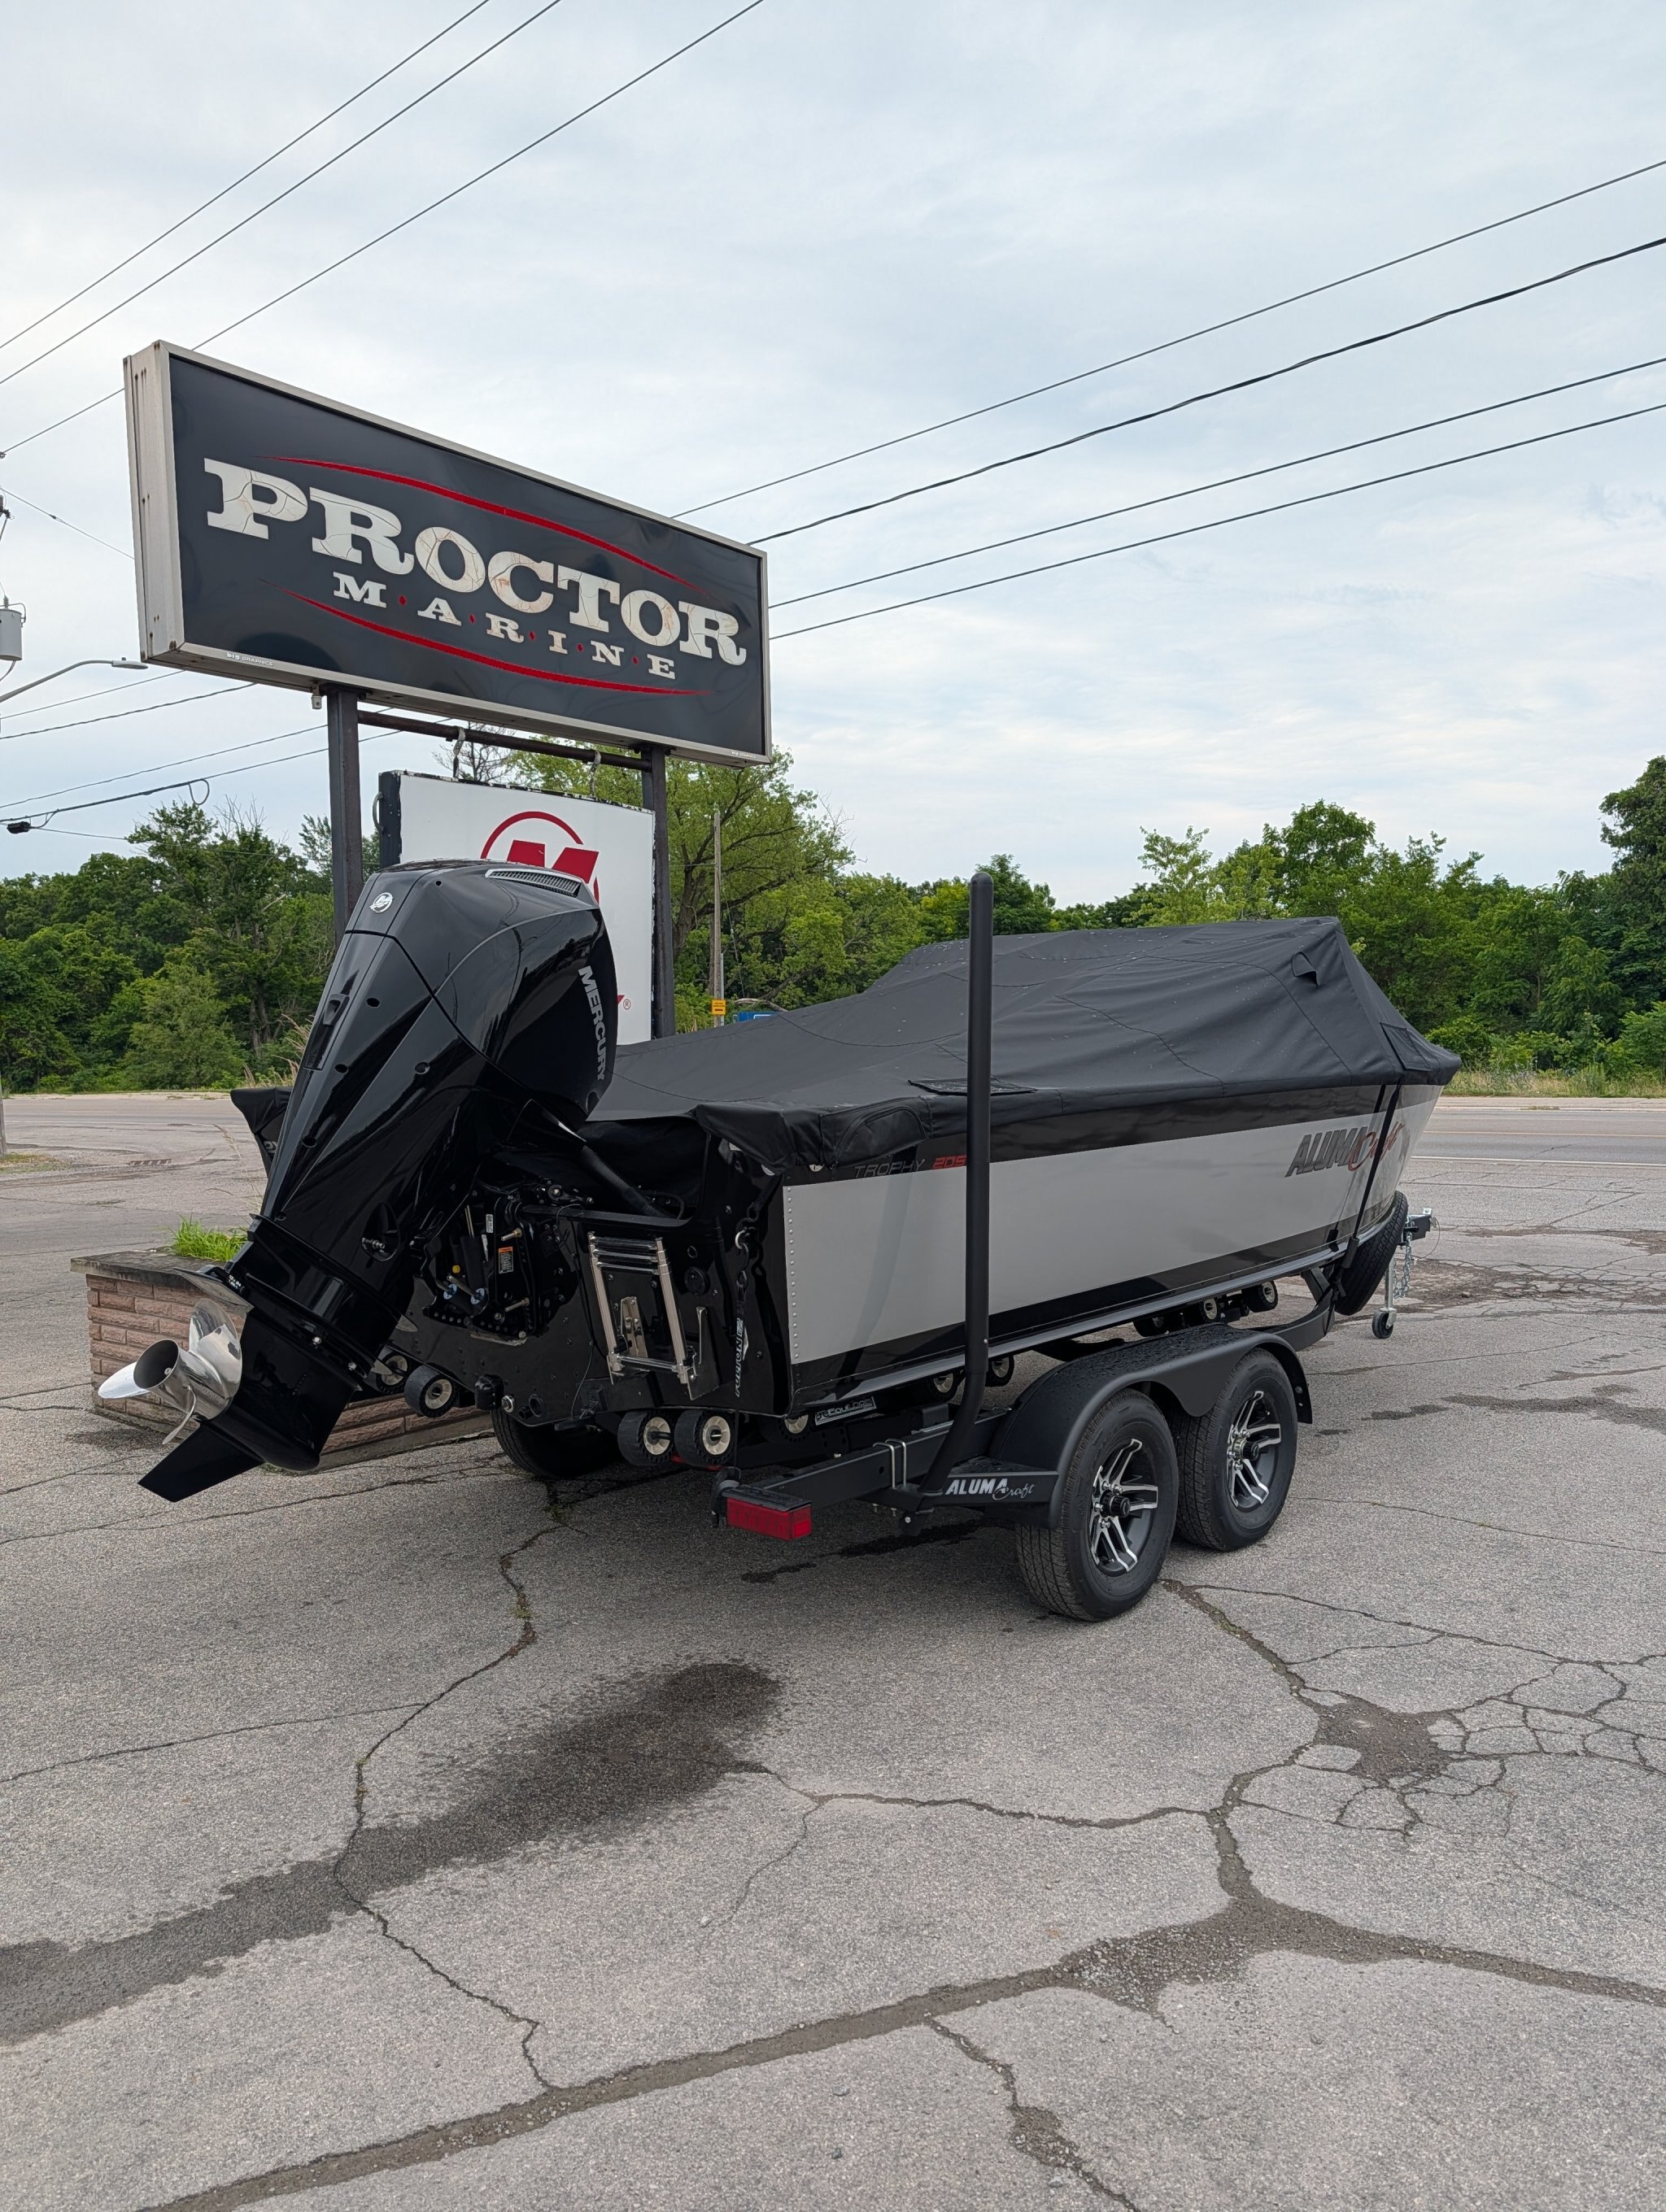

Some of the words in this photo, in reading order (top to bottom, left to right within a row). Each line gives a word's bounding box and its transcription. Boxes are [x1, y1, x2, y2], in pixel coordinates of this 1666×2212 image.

[204, 458, 747, 666] PROCTOR
[578, 965, 607, 1081] MERCURY
[854, 1159, 926, 1178] TROPHY
